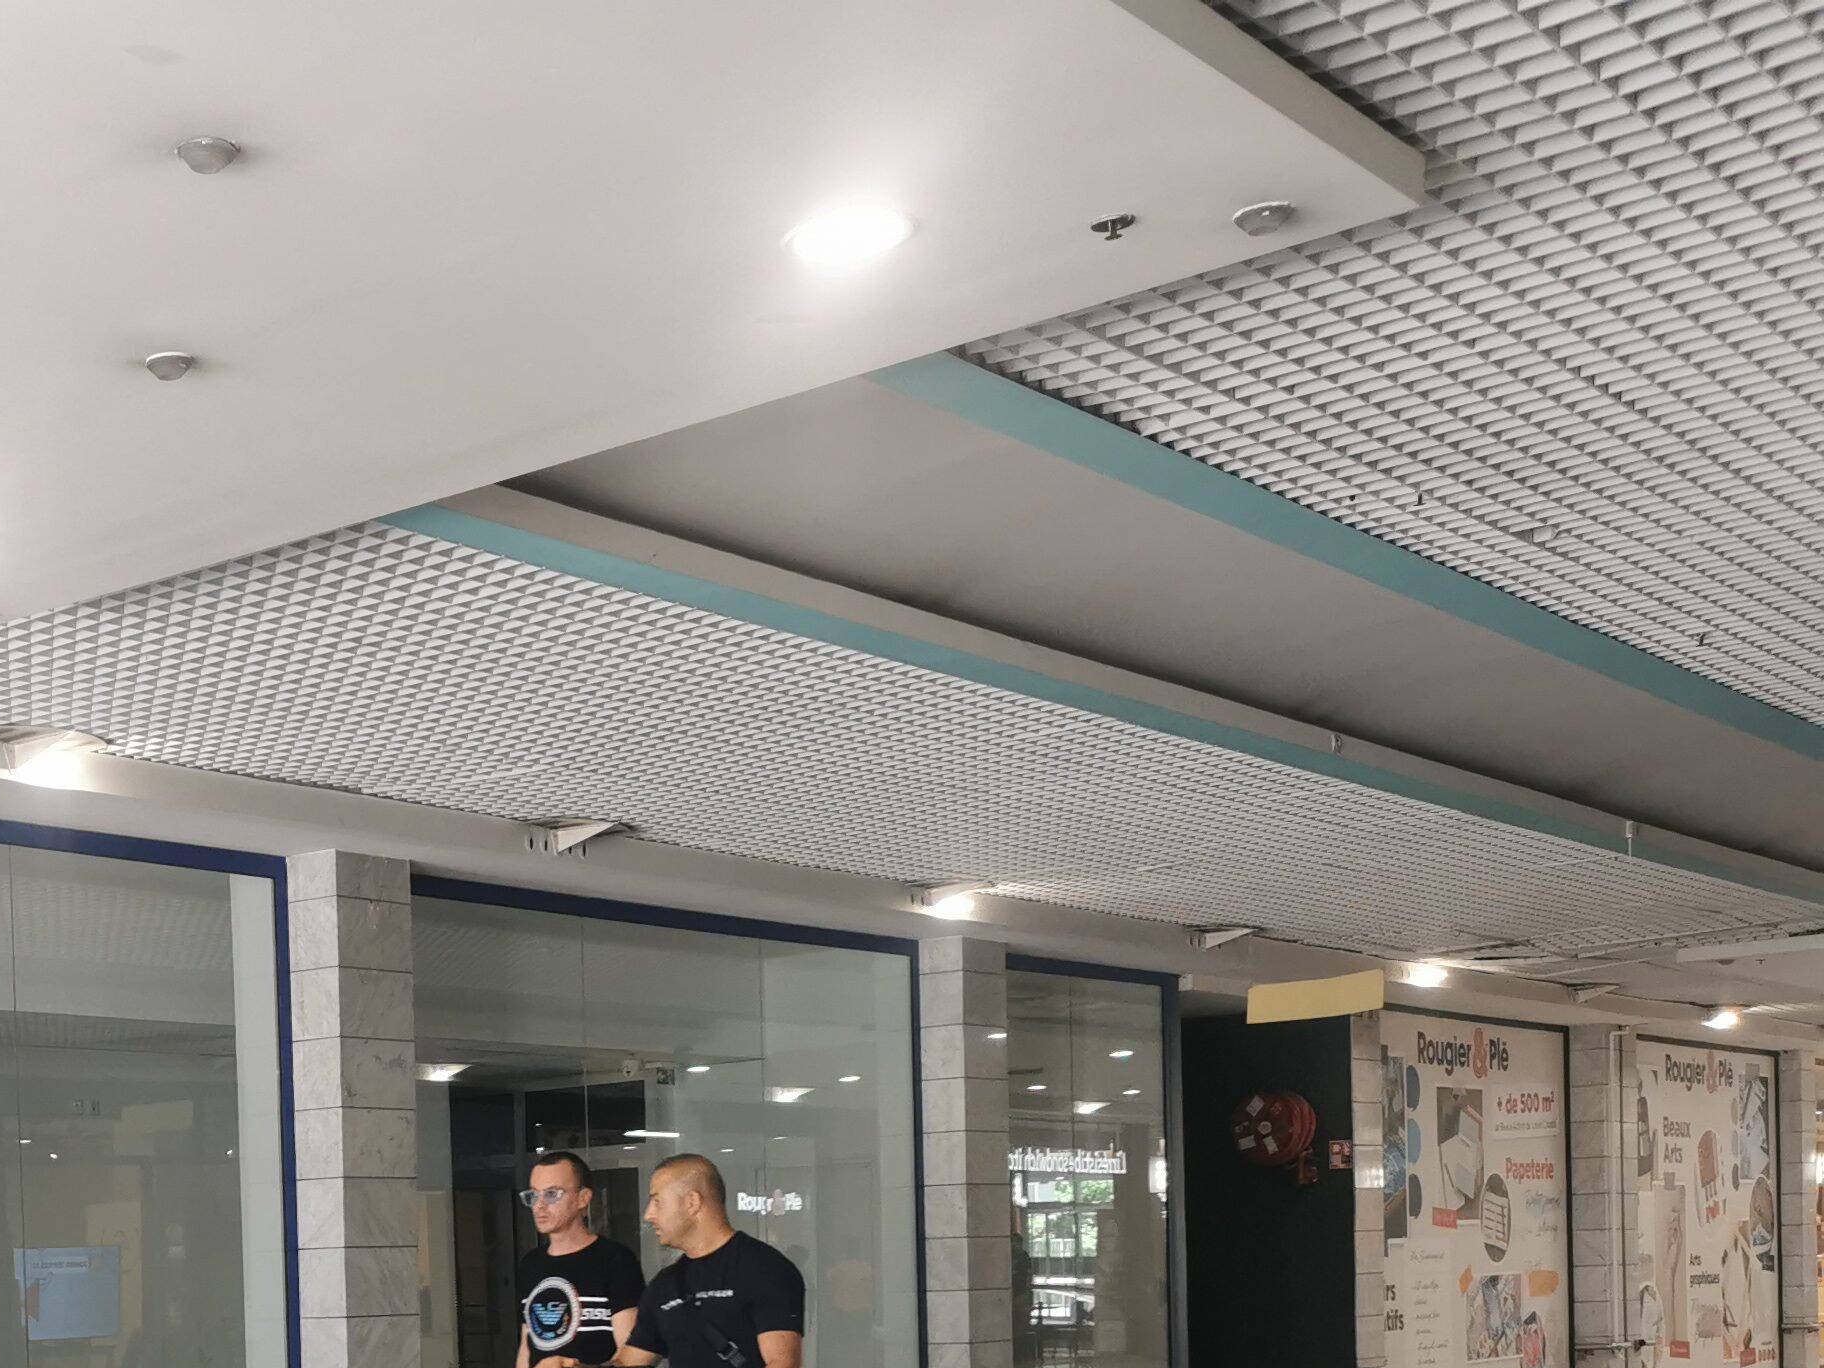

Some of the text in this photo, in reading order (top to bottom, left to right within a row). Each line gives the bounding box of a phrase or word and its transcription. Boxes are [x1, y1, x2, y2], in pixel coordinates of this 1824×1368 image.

[1417, 1031, 1471, 1077] Rougier
[1664, 1054, 1706, 1092] Rougier
[1505, 1093, 1518, 1114] de
[1520, 1092, 1540, 1114] 500
[1663, 1116, 1691, 1139] Beaux
[1664, 1143, 1683, 1163] Arts
[1505, 1157, 1555, 1184] Papeterie
